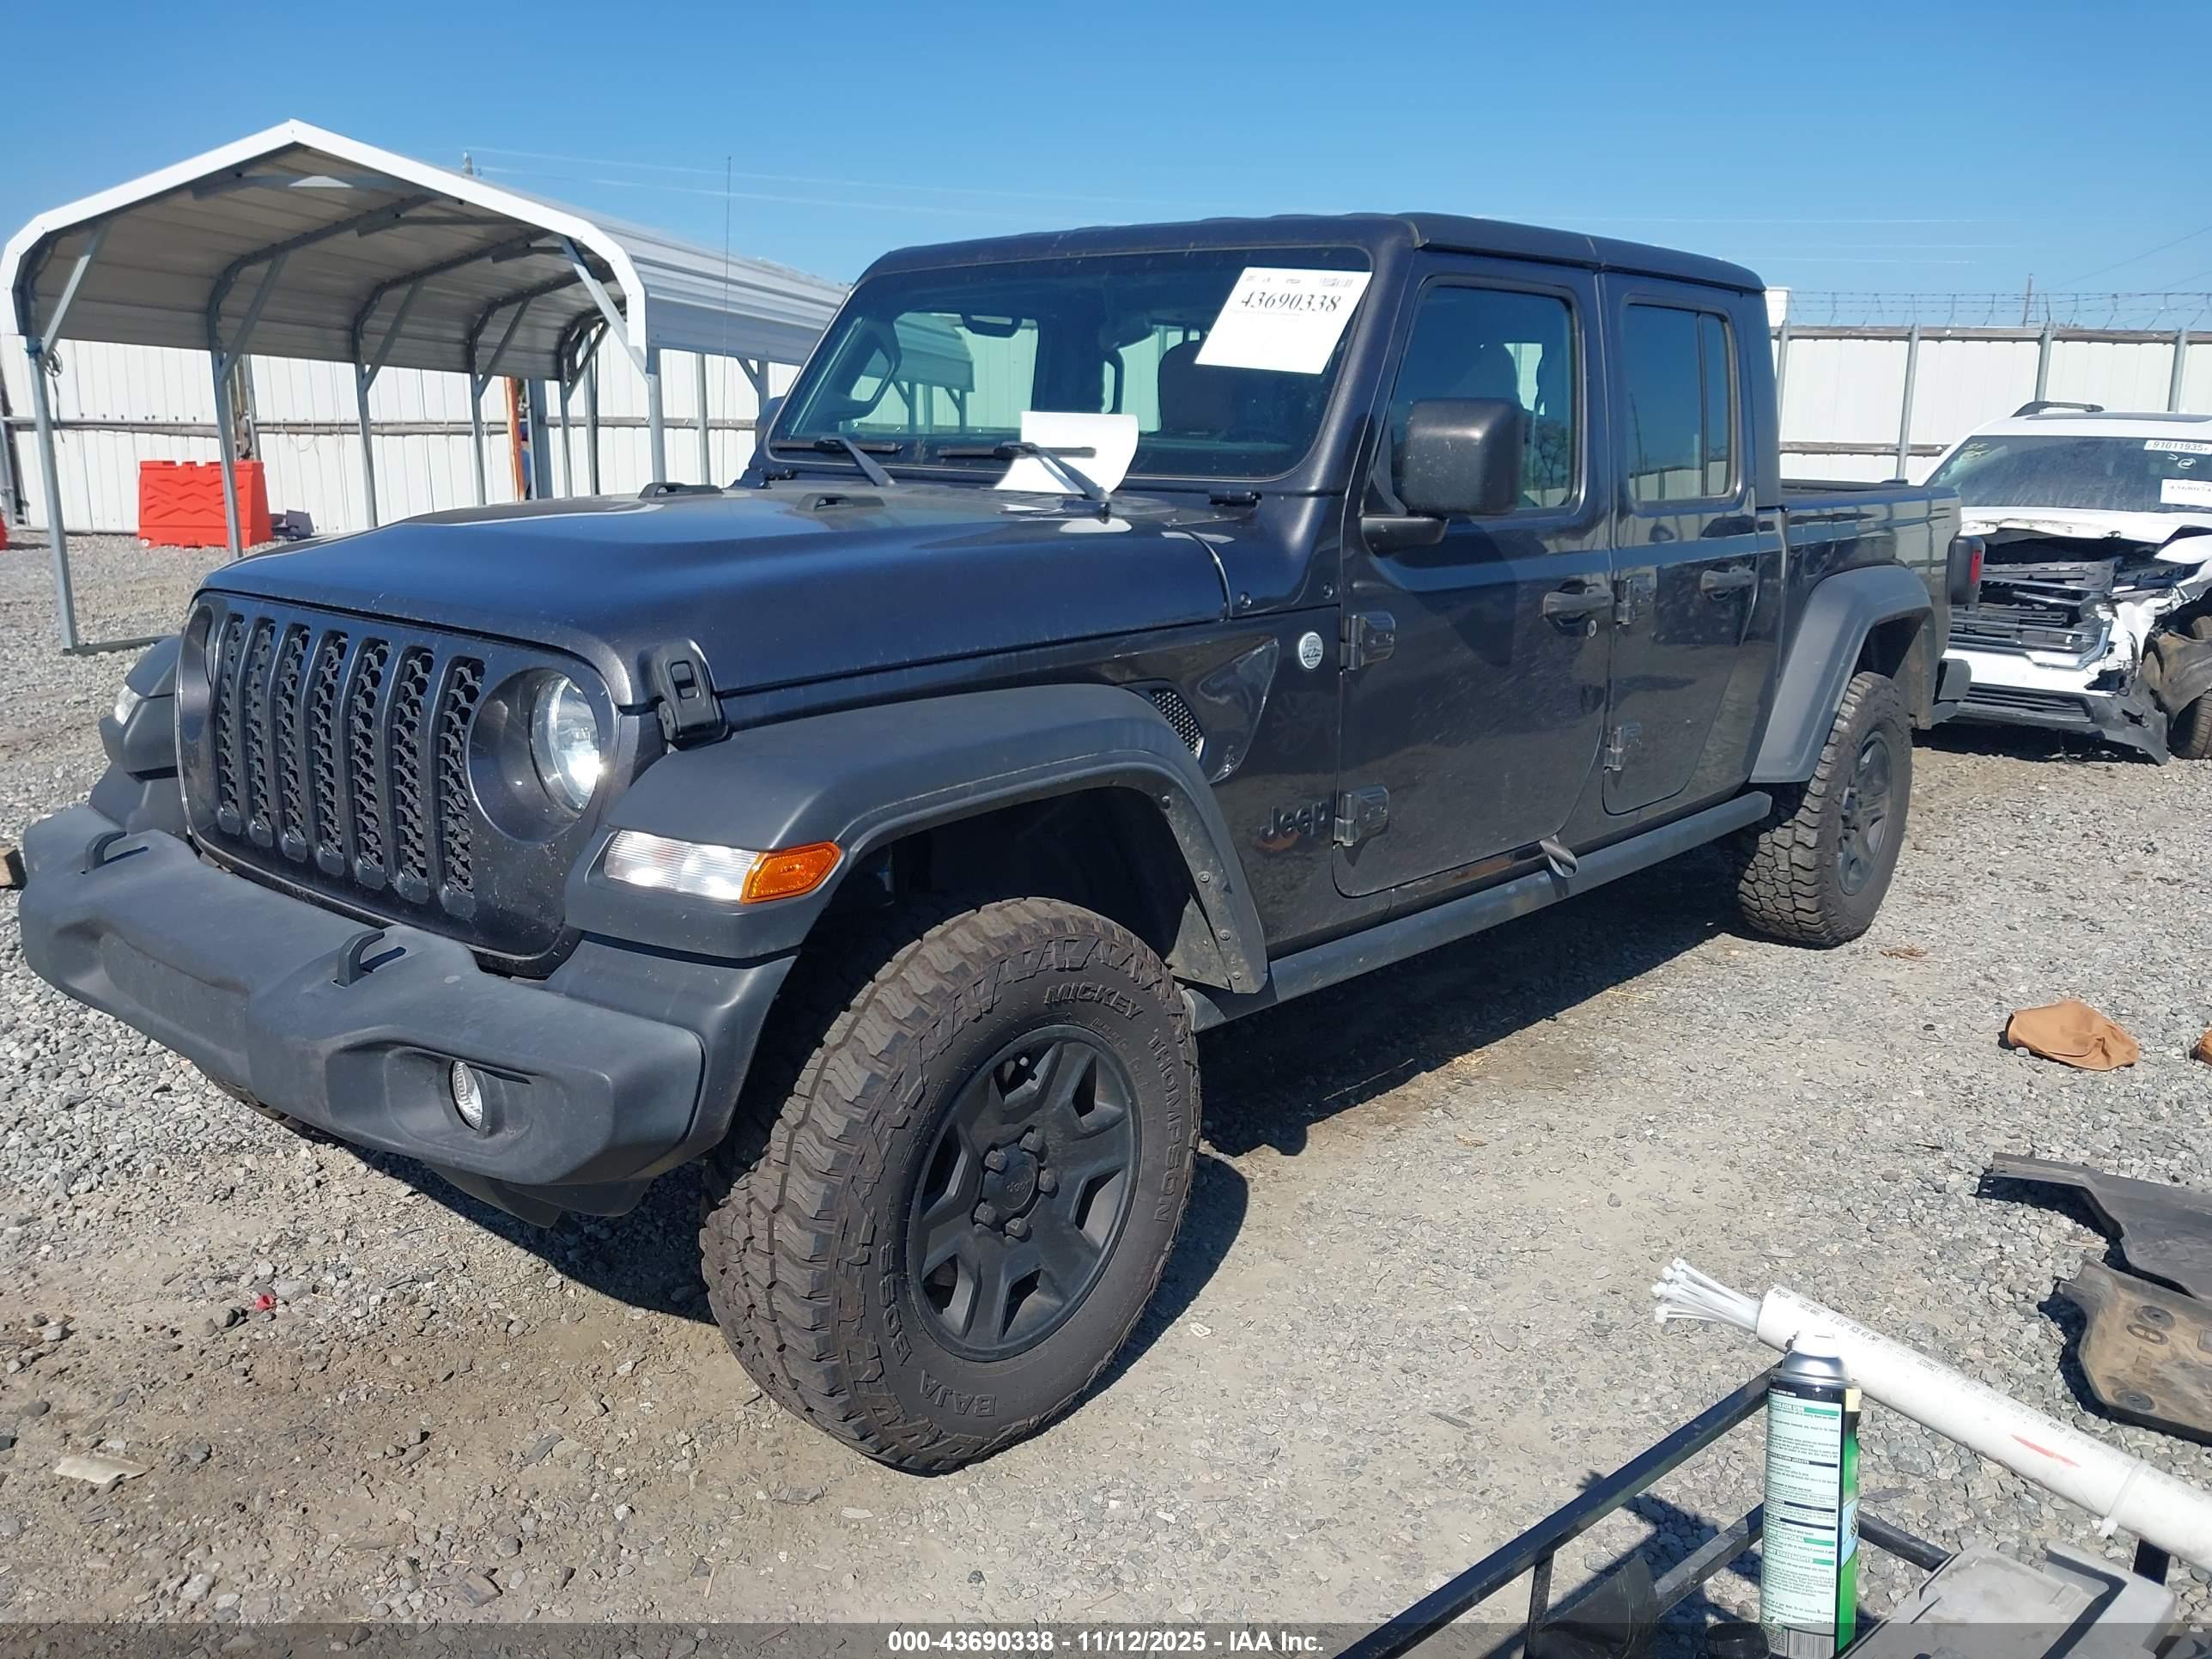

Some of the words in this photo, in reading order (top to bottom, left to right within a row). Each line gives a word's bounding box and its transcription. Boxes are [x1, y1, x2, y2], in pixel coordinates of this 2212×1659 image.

[1241, 290, 1341, 313] 43690338
[2152, 441, 2203, 452] 91011935
[1258, 801, 1328, 839] Jeep
[1043, 981, 1144, 1020] MICKEY
[1147, 1026, 1182, 1223] THOMPSON
[878, 1239, 913, 1366] BOSS
[920, 1369, 997, 1416] BAJA
